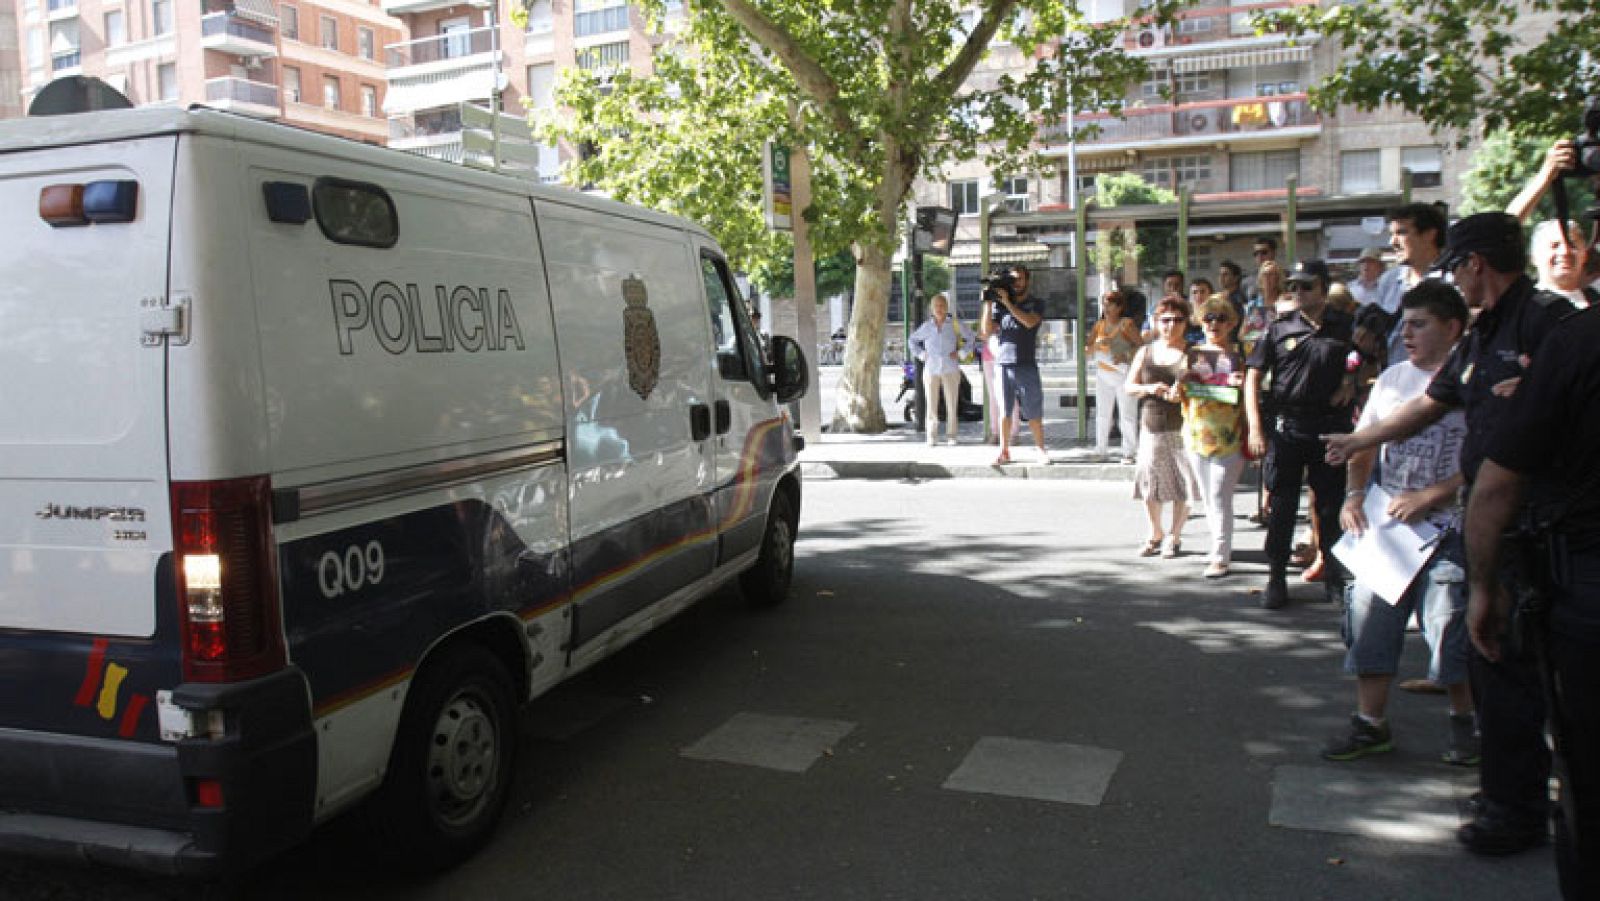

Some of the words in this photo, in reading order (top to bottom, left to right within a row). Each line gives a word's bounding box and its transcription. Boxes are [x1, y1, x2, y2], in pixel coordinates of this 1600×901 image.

[329, 279, 525, 355] POLICIA
[35, 503, 145, 521] JUMPER
[319, 541, 384, 598] Q09
